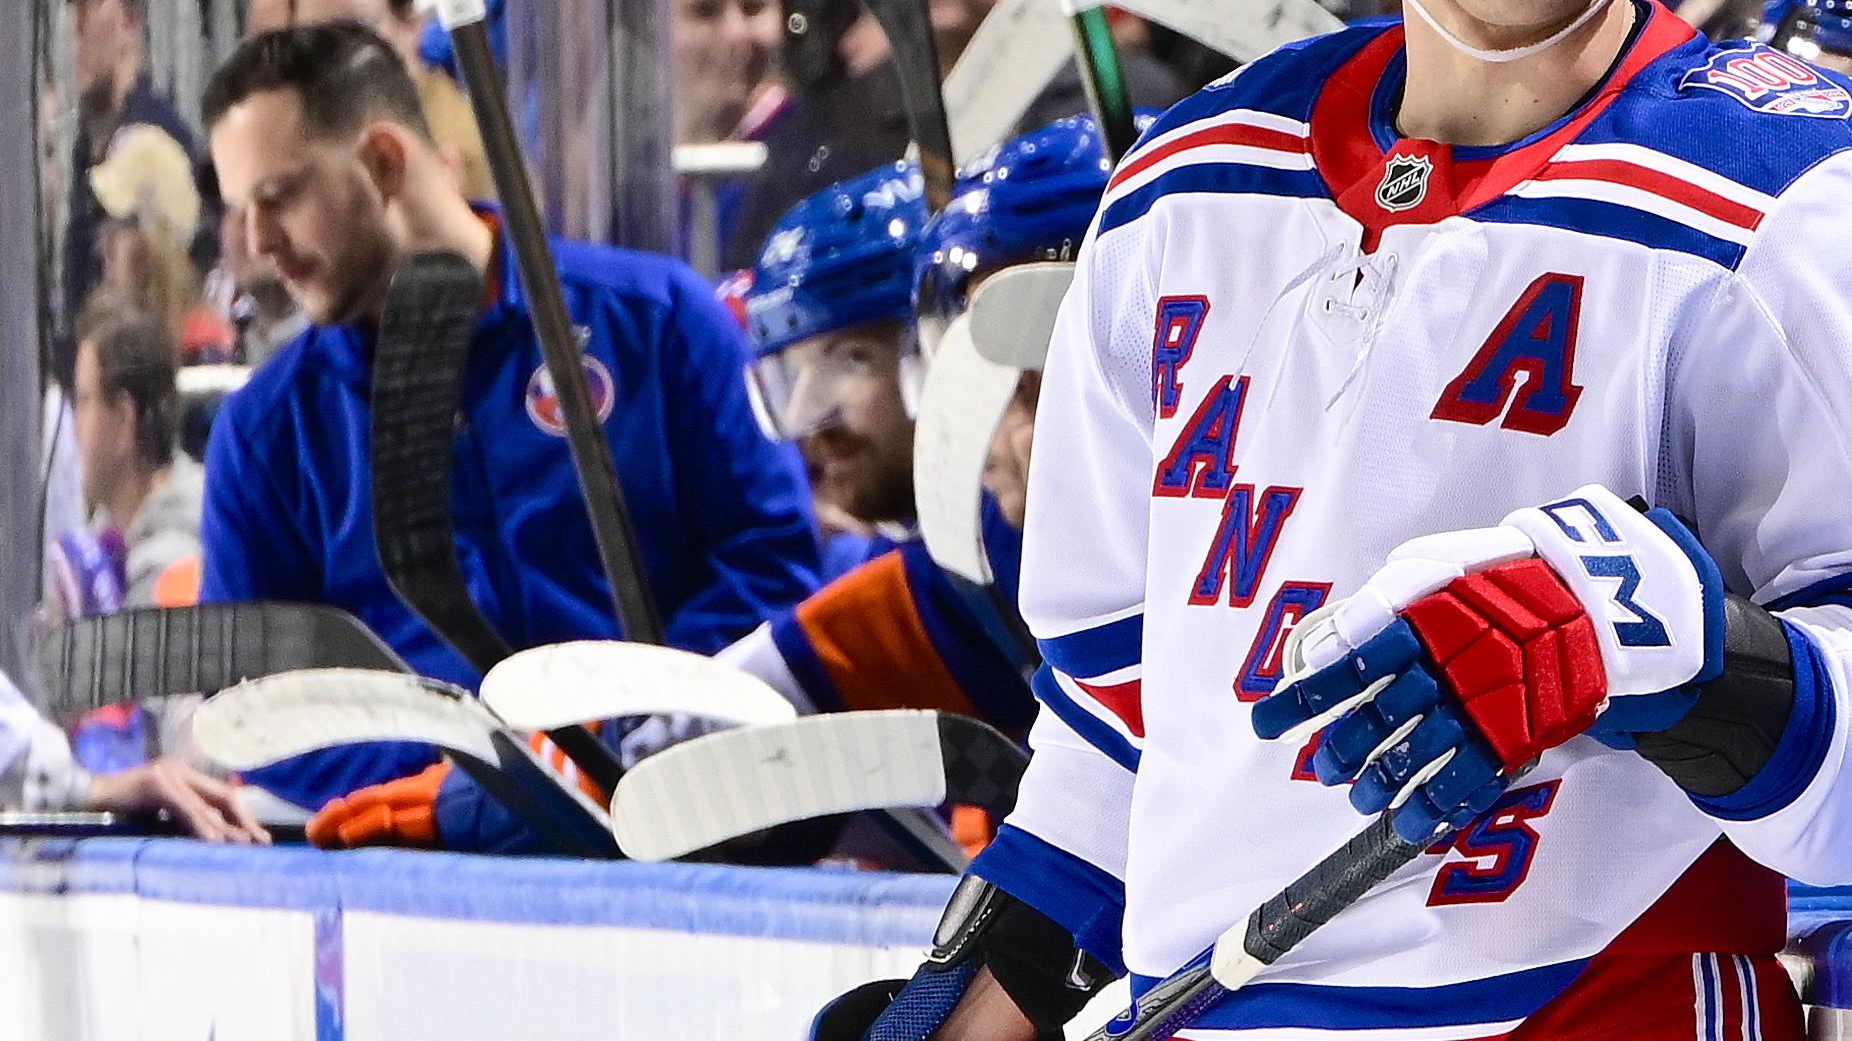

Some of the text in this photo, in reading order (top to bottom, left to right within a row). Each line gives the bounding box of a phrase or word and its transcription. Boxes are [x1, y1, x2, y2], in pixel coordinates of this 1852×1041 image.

[1707, 51, 1818, 101] 100
[1386, 171, 1421, 199] NHL
[1432, 272, 1586, 437] A
